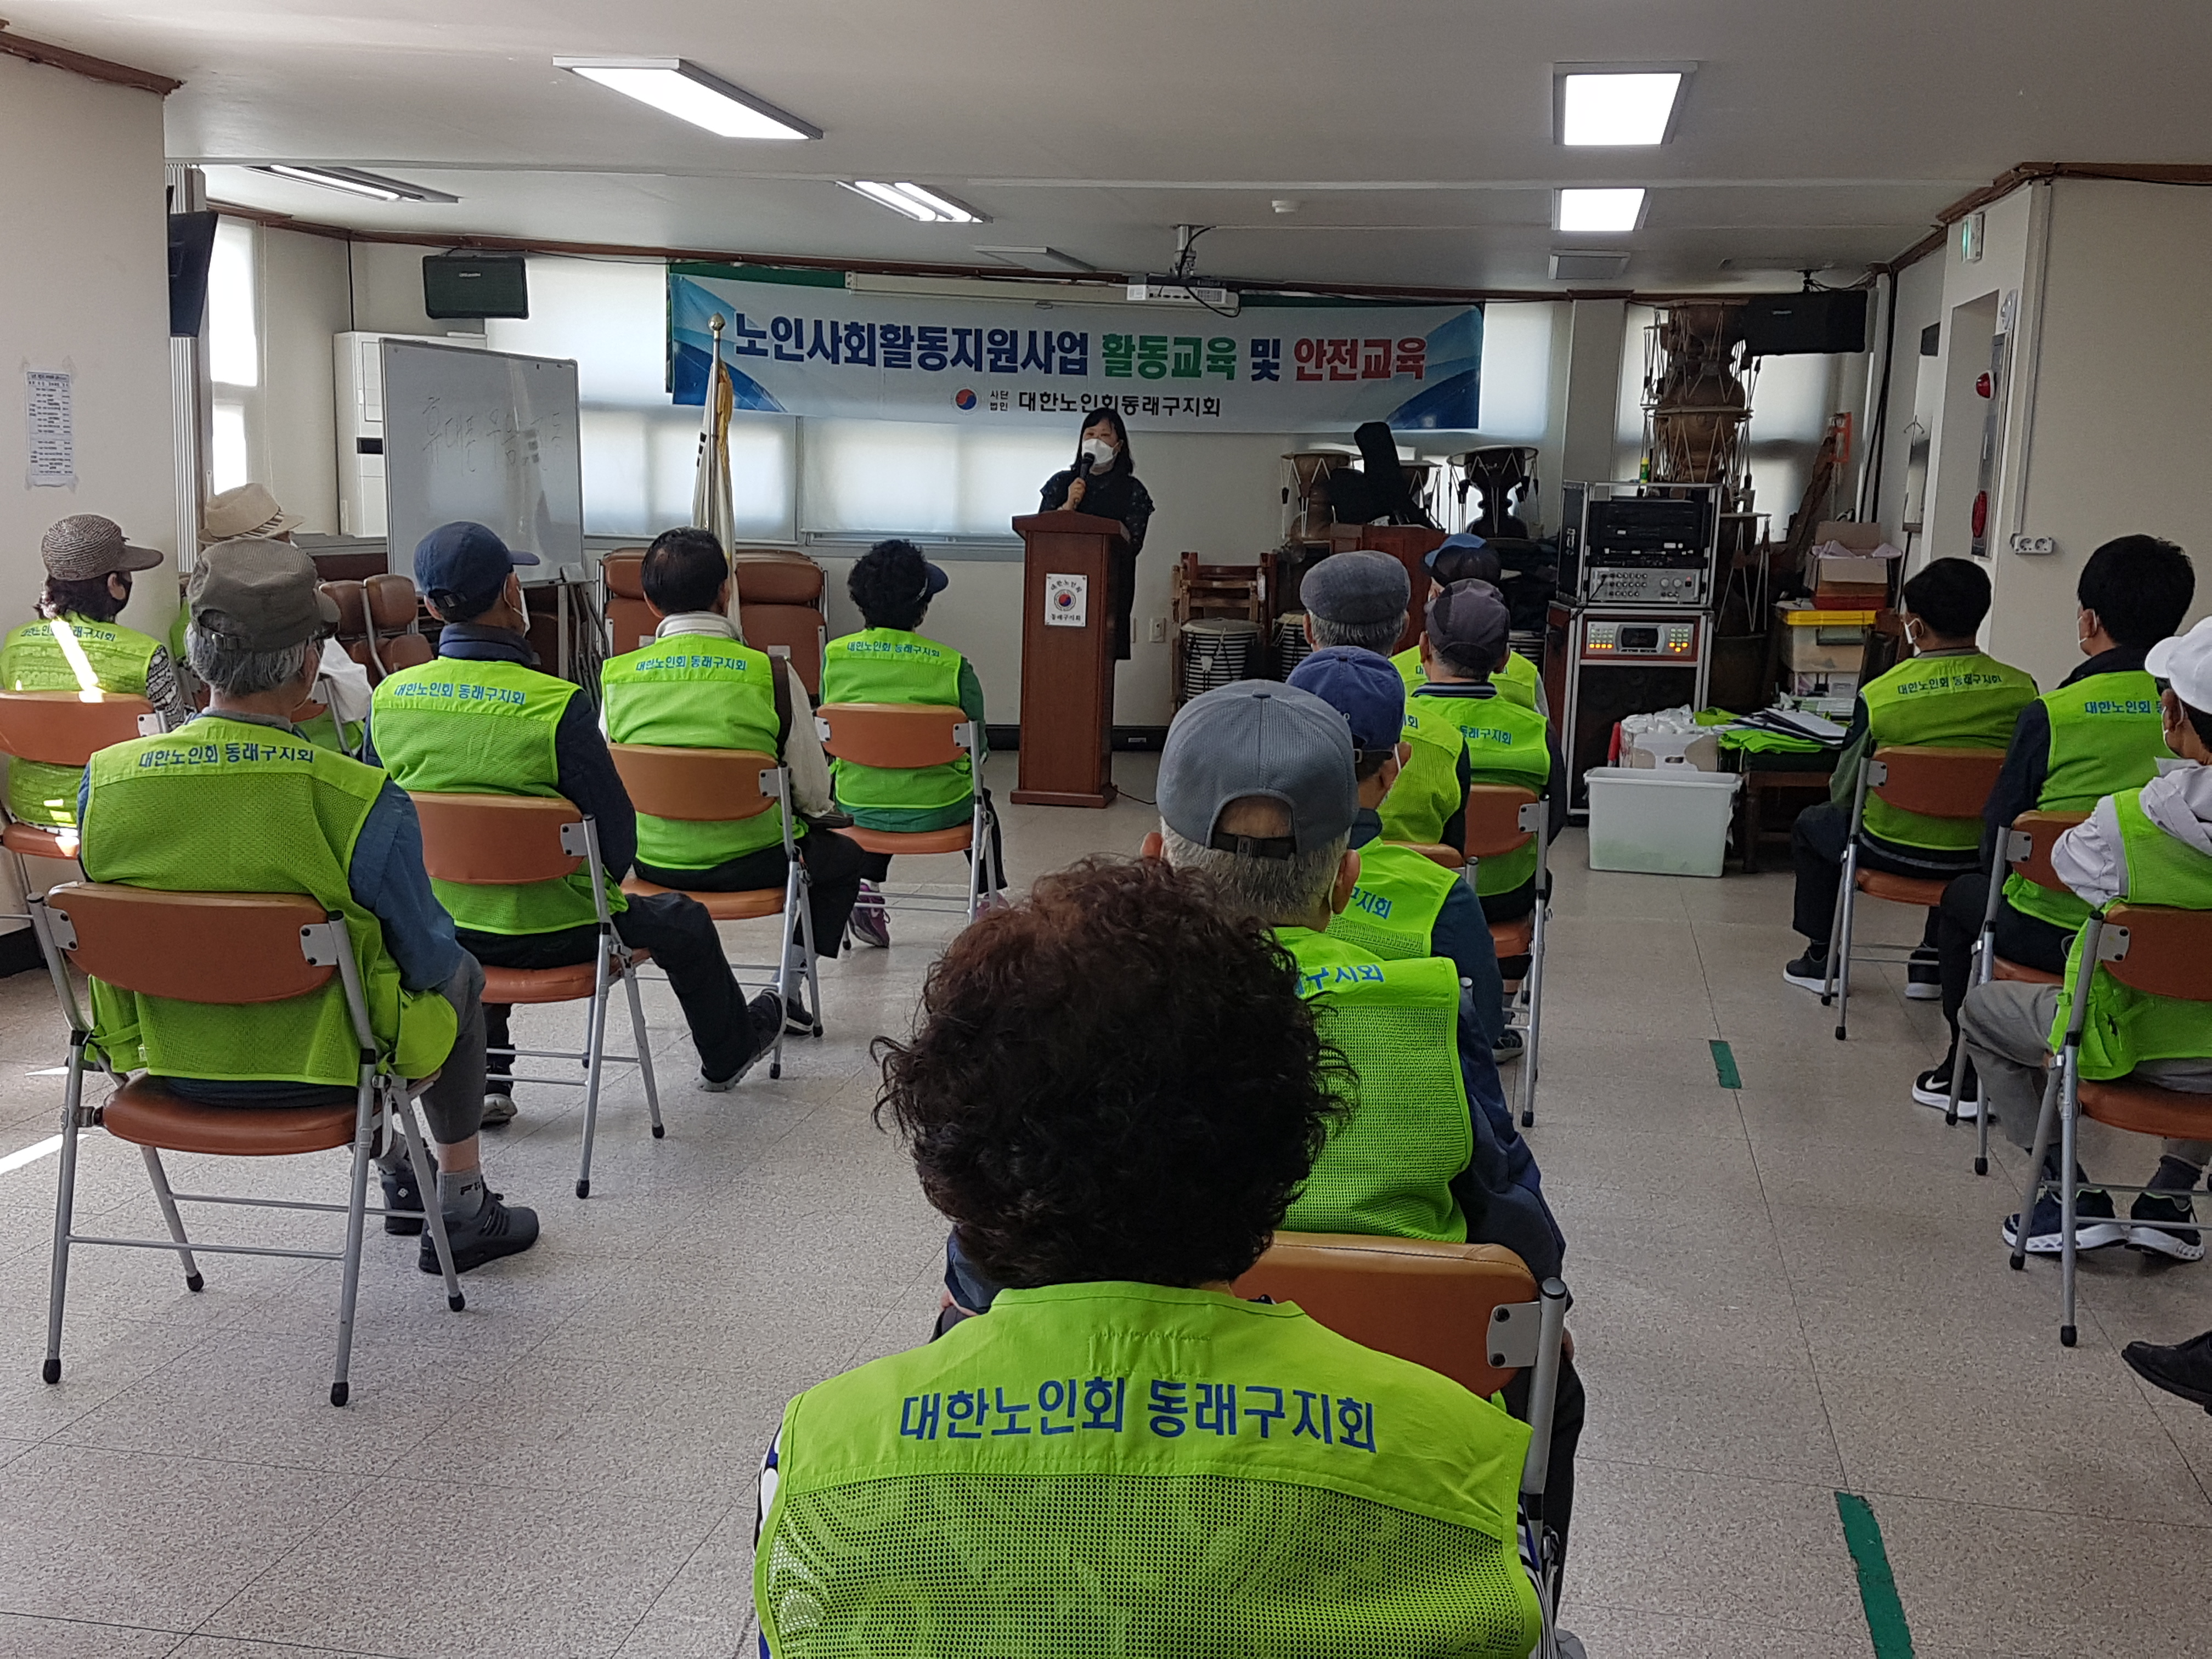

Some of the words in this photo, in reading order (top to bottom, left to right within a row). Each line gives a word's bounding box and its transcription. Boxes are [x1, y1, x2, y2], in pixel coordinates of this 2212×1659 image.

[735, 312, 1088, 376] 노인사회활동지원사업
[1102, 333, 1237, 380] 활동교육
[1250, 338, 1280, 382] 및
[1294, 336, 1427, 381] 안전교육
[990, 390, 1008, 399] 사단
[1019, 386, 1221, 417] 대한노인회동래구지회
[990, 402, 1008, 411] 법인
[71, 625, 116, 642] 래구지회
[636, 655, 686, 671] 대한노인회
[691, 655, 746, 671] 동래구지회
[394, 682, 454, 697] 대한노인회
[458, 684, 526, 705] 동래구지회
[1898, 676, 1949, 695] 대한노인회
[2085, 700, 2151, 714] 대한노인회
[139, 744, 218, 768] 대한노인회
[225, 742, 314, 763] 동래구지회
[899, 1375, 1126, 1441] 대한노인회
[1147, 1378, 1378, 1454] 동래구지회
